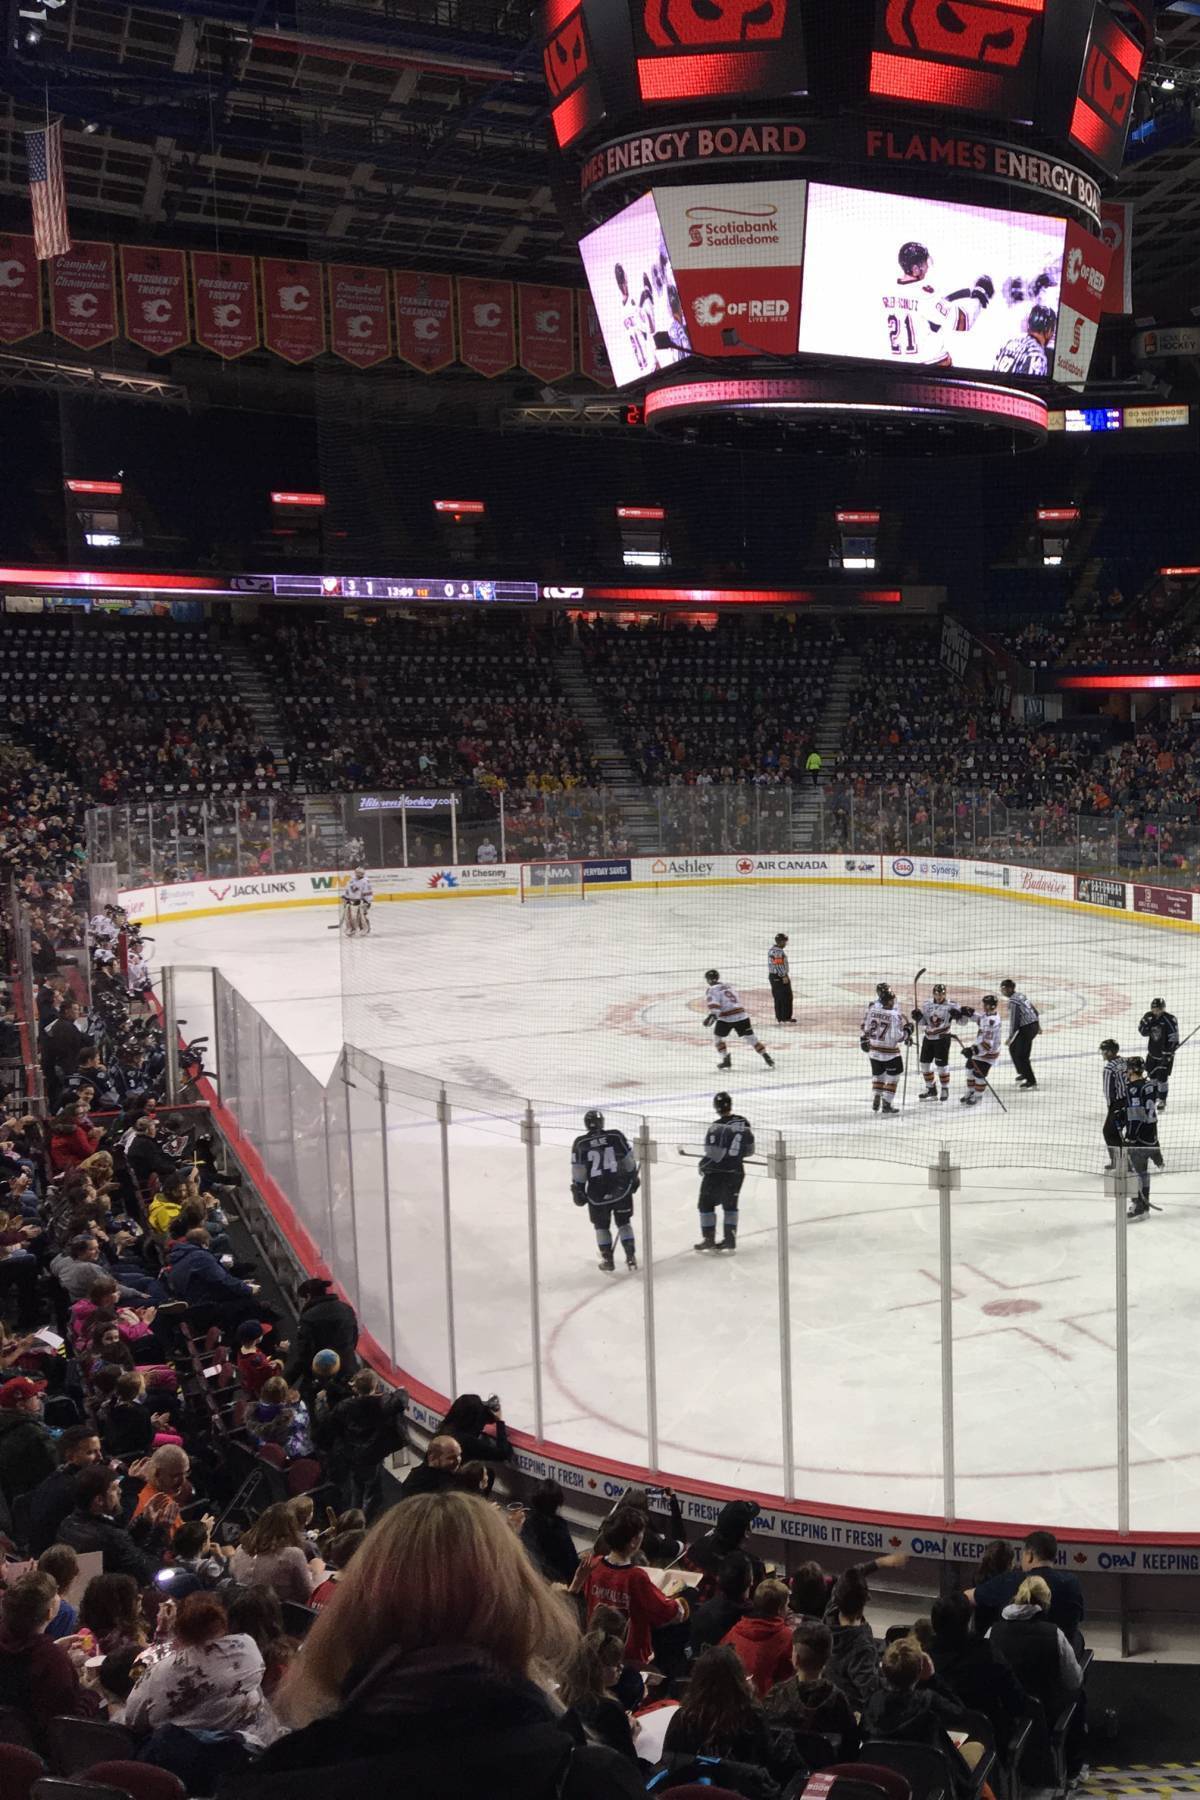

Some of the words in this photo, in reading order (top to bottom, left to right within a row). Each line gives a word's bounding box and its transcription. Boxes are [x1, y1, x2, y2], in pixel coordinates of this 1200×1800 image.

[607, 130, 690, 175] ENERGY
[697, 125, 807, 157] BOARD
[866, 130, 987, 171] FLAMES
[994, 147, 1077, 196] ENERGY
[706, 220, 778, 235] Scotiabank
[706, 233, 779, 247] Saddledome
[727, 303, 747, 316] OF
[749, 300, 790, 317] RED
[887, 313, 918, 355] 21
[444, 583, 455, 597] 0
[477, 866, 507, 879] Chesney
[668, 859, 725, 875] Ashley
[756, 861, 778, 870] AIR
[778, 861, 828, 871] CANADA
[931, 863, 959, 879] Synergy
[232, 884, 260, 898] JACK
[869, 1018, 889, 1042] 27
[587, 1146, 618, 1178] 24
[557, 1469, 585, 1488] FRESH
[688, 1503, 721, 1524] FRESH
[780, 1519, 828, 1542] KEEPING
[831, 1527, 843, 1543] IT
[845, 1529, 884, 1548] FRESH
[911, 1536, 946, 1554] OPA!
[1097, 1551, 1137, 1570] OPA!
[1143, 1553, 1199, 1570] KEEPING
